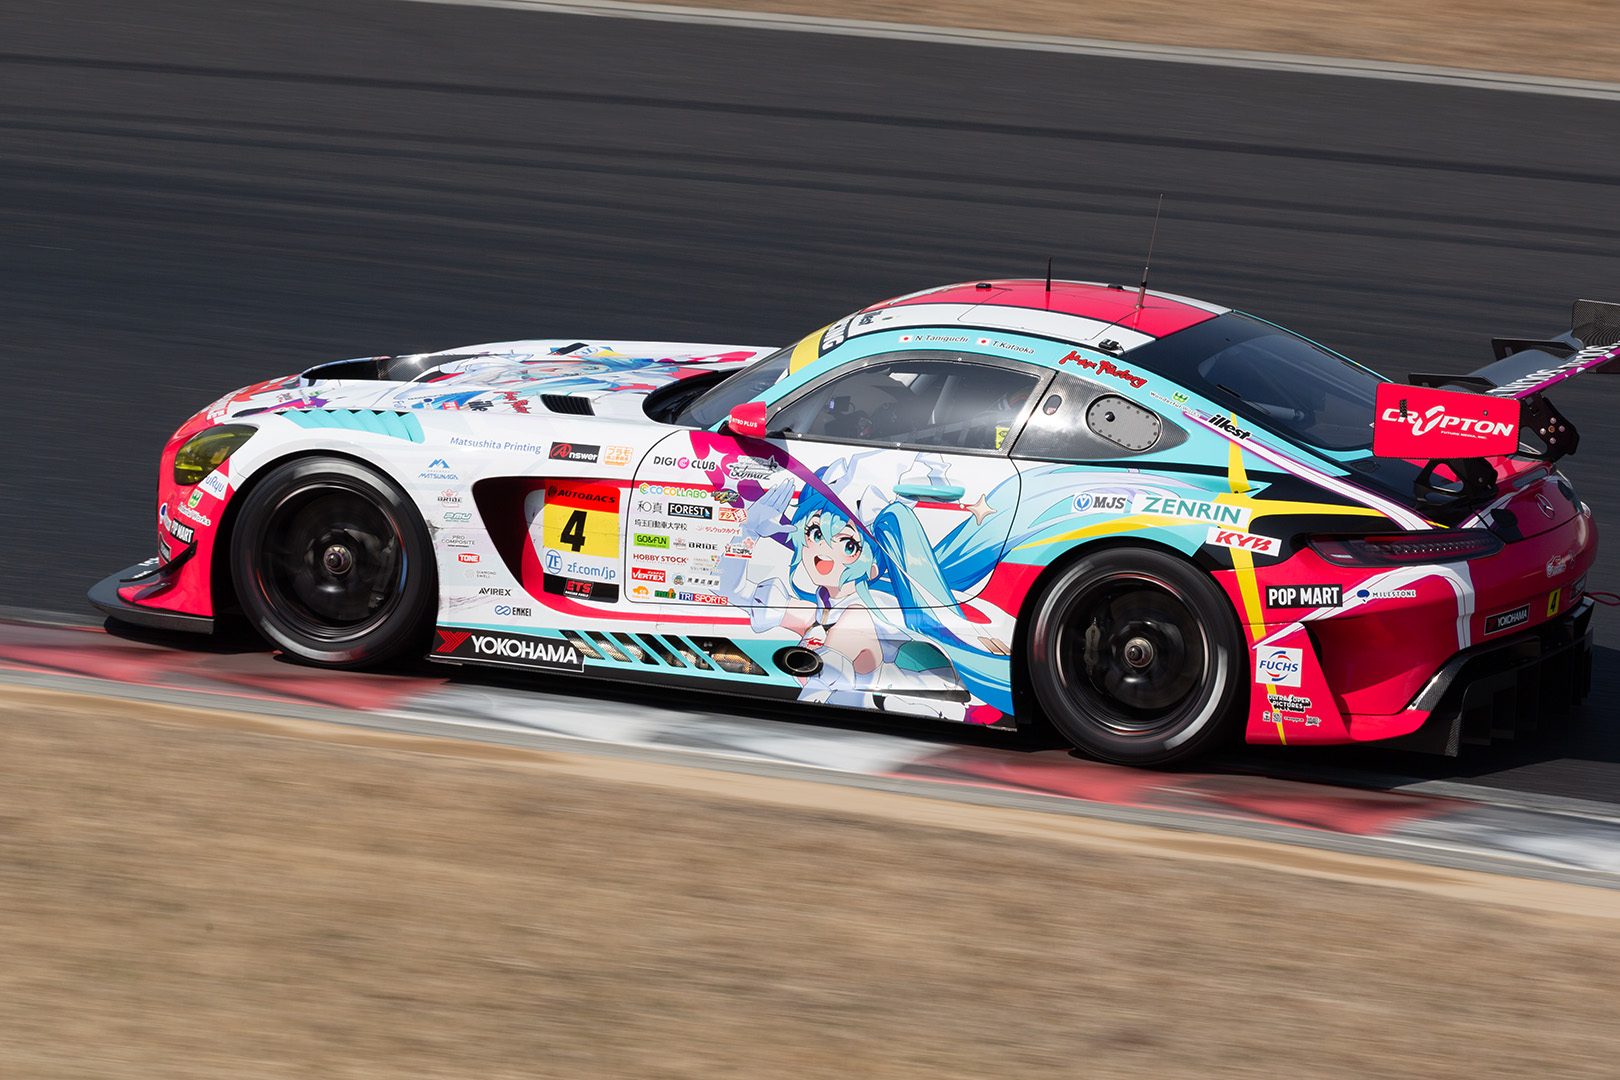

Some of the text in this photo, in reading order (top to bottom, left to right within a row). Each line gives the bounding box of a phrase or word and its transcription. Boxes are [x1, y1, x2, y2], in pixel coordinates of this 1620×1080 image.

[992, 340, 1035, 354] T.Kataoka
[1096, 360, 1148, 389] Factory
[1208, 414, 1251, 440] illest
[450, 437, 542, 454] Matsushita Printing
[550, 443, 598, 461] Answer
[653, 456, 716, 470] DIGI CLUB
[557, 488, 616, 503] AUTOBACS
[650, 485, 707, 499] COCOLLABO
[670, 504, 705, 516] FOREST
[1093, 496, 1127, 509] MJS
[1141, 496, 1242, 524] ZENRIN
[560, 510, 588, 552] 4
[1215, 531, 1273, 552] KYB
[459, 554, 479, 562] TONE
[546, 553, 561, 570] ZF
[633, 553, 660, 561] HOBBY
[661, 555, 688, 564] STOCK
[567, 562, 616, 580] zf.com/jp
[632, 569, 664, 582] VERTEX
[478, 587, 512, 597] AVIREX
[566, 580, 592, 594] ETS
[1372, 590, 1417, 598] MILESTONE
[693, 593, 728, 606] SPORTS
[1268, 587, 1340, 606] POP MART
[1550, 592, 1558, 612] 4
[1497, 609, 1528, 627] YOKOHAMA
[471, 635, 578, 665] YOKOHAMA
[1259, 660, 1299, 672] FUCHS
